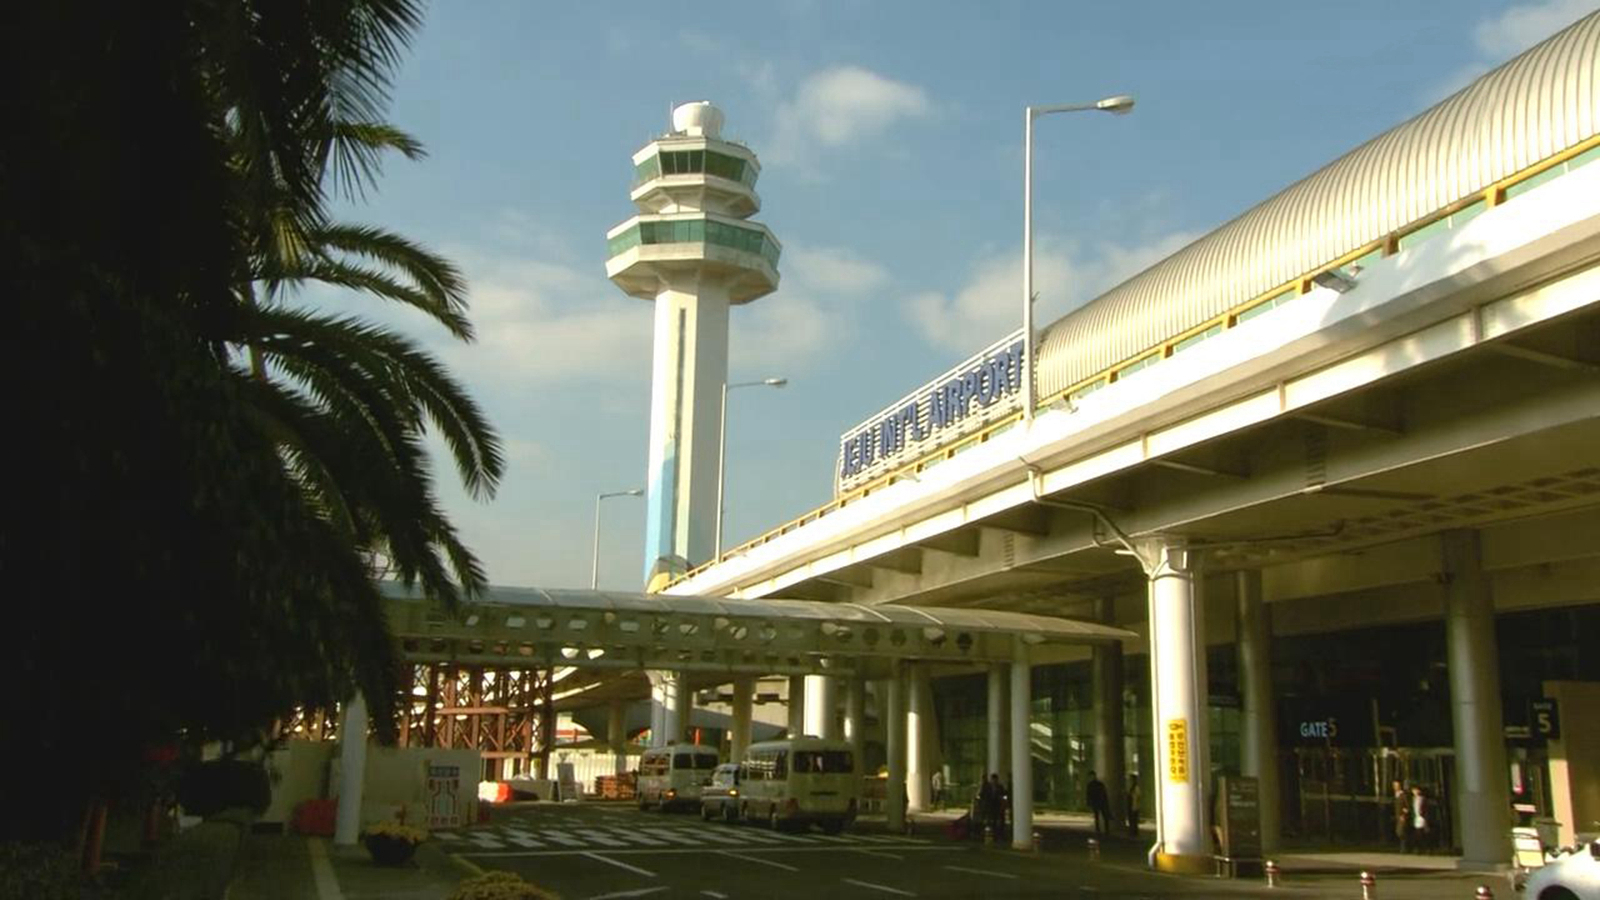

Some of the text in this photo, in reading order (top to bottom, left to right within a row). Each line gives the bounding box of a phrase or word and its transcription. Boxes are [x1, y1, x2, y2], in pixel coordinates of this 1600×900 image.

[928, 338, 1024, 434] AIRPORT
[1300, 721, 1328, 738] GATE
[1537, 712, 1551, 733] 5
